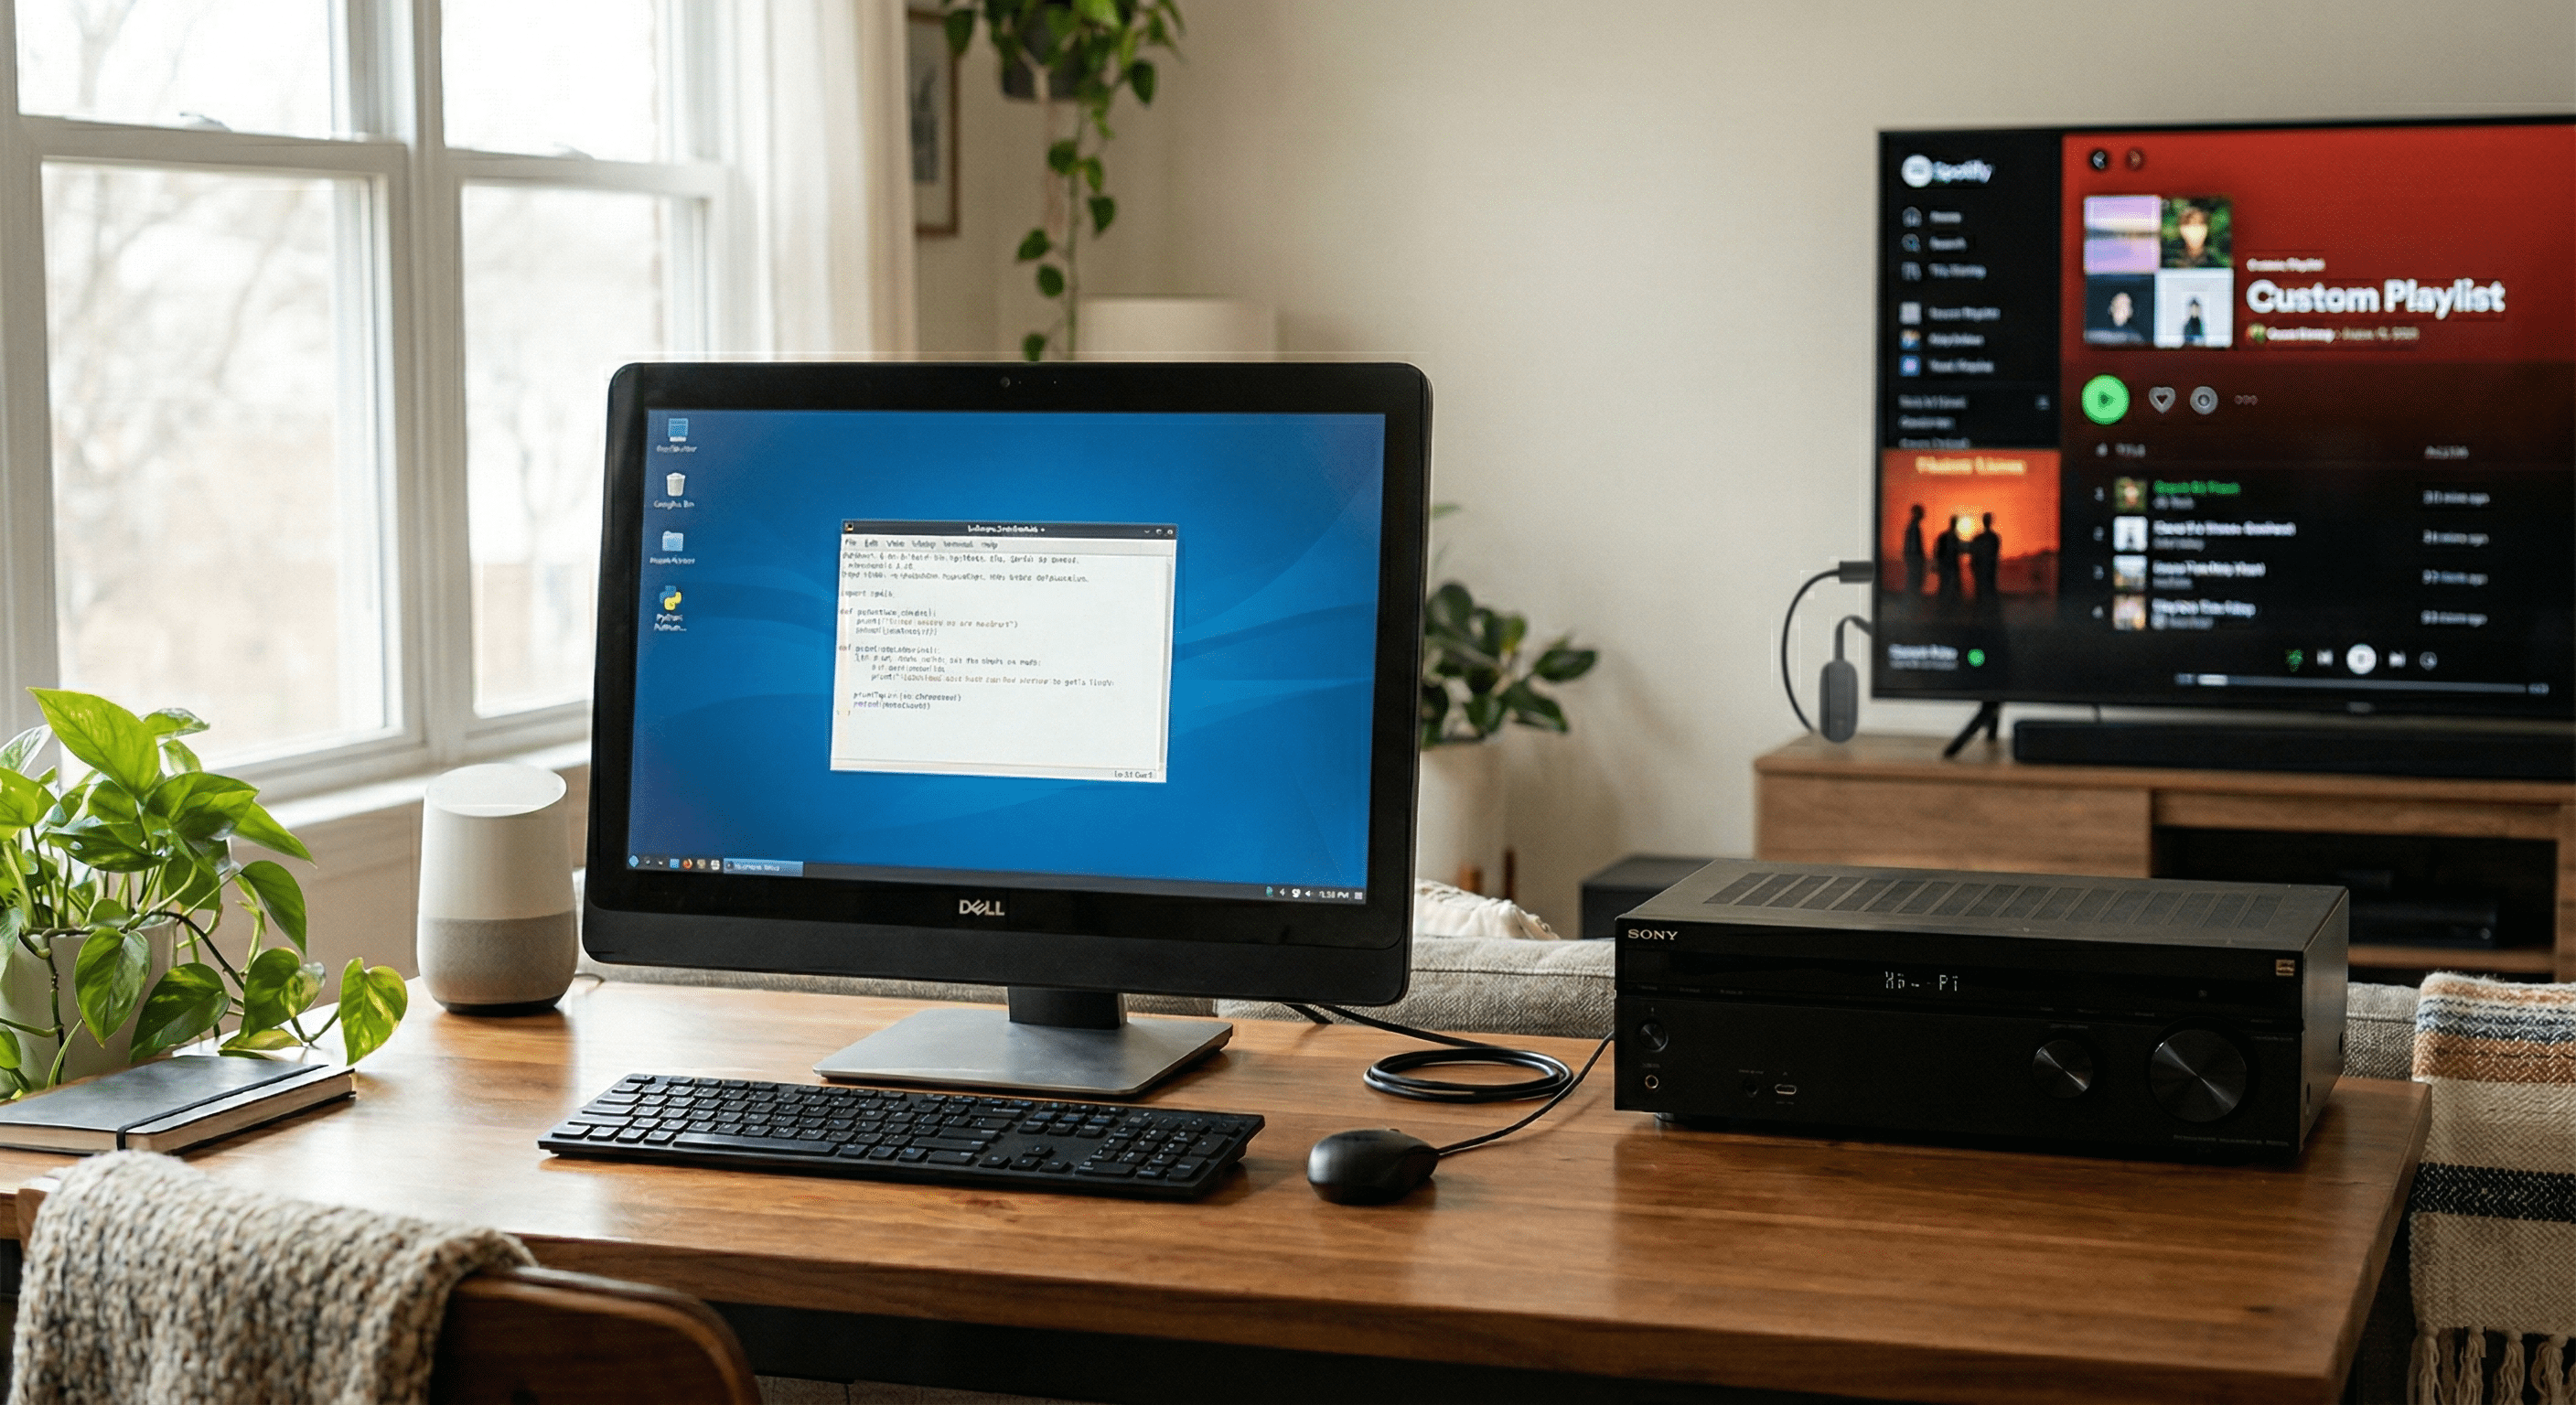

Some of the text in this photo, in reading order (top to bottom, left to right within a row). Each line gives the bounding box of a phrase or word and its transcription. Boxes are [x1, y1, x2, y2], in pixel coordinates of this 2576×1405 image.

[2247, 278, 2506, 320] Custom Playlist
[959, 899, 1005, 917] DELL
[1627, 928, 1678, 940] SONY
